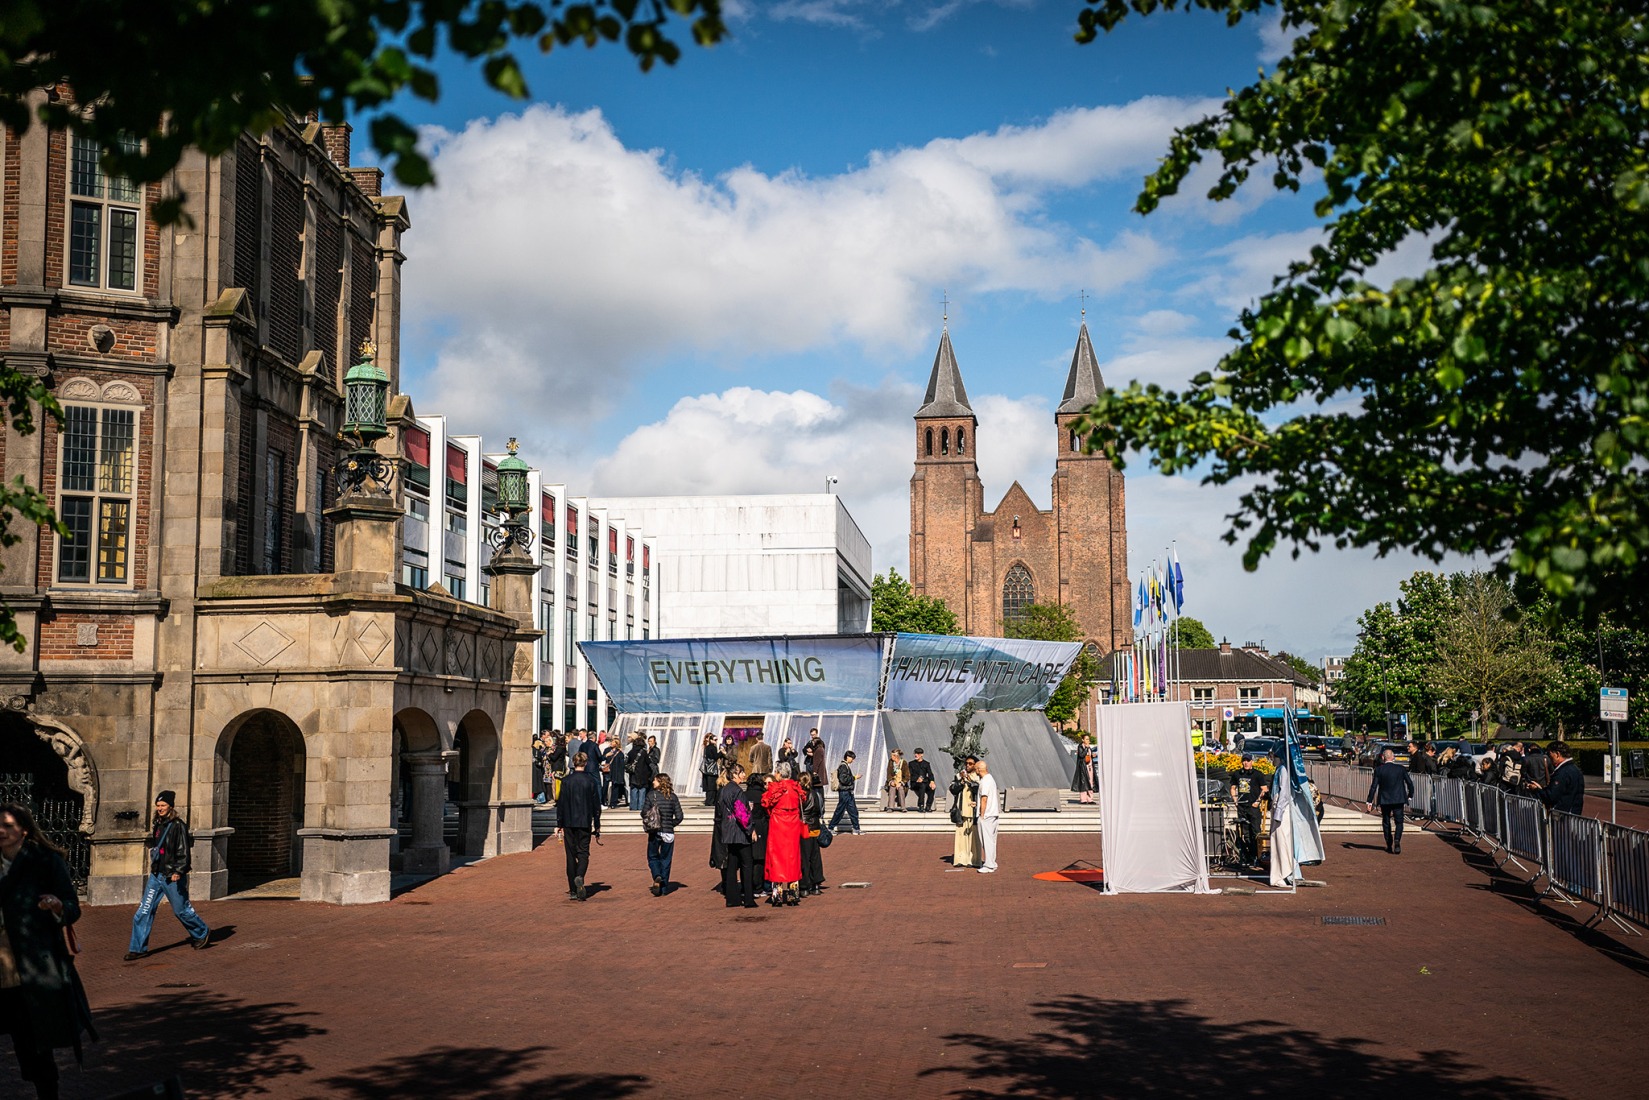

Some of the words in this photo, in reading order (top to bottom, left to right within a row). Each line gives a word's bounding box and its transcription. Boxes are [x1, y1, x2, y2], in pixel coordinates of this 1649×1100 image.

[650, 656, 826, 685] EVERYTHING
[892, 656, 973, 684] HANDLE
[973, 659, 1019, 685] WITH
[1017, 661, 1064, 684] CARE
[142, 889, 155, 914] HUMAN
